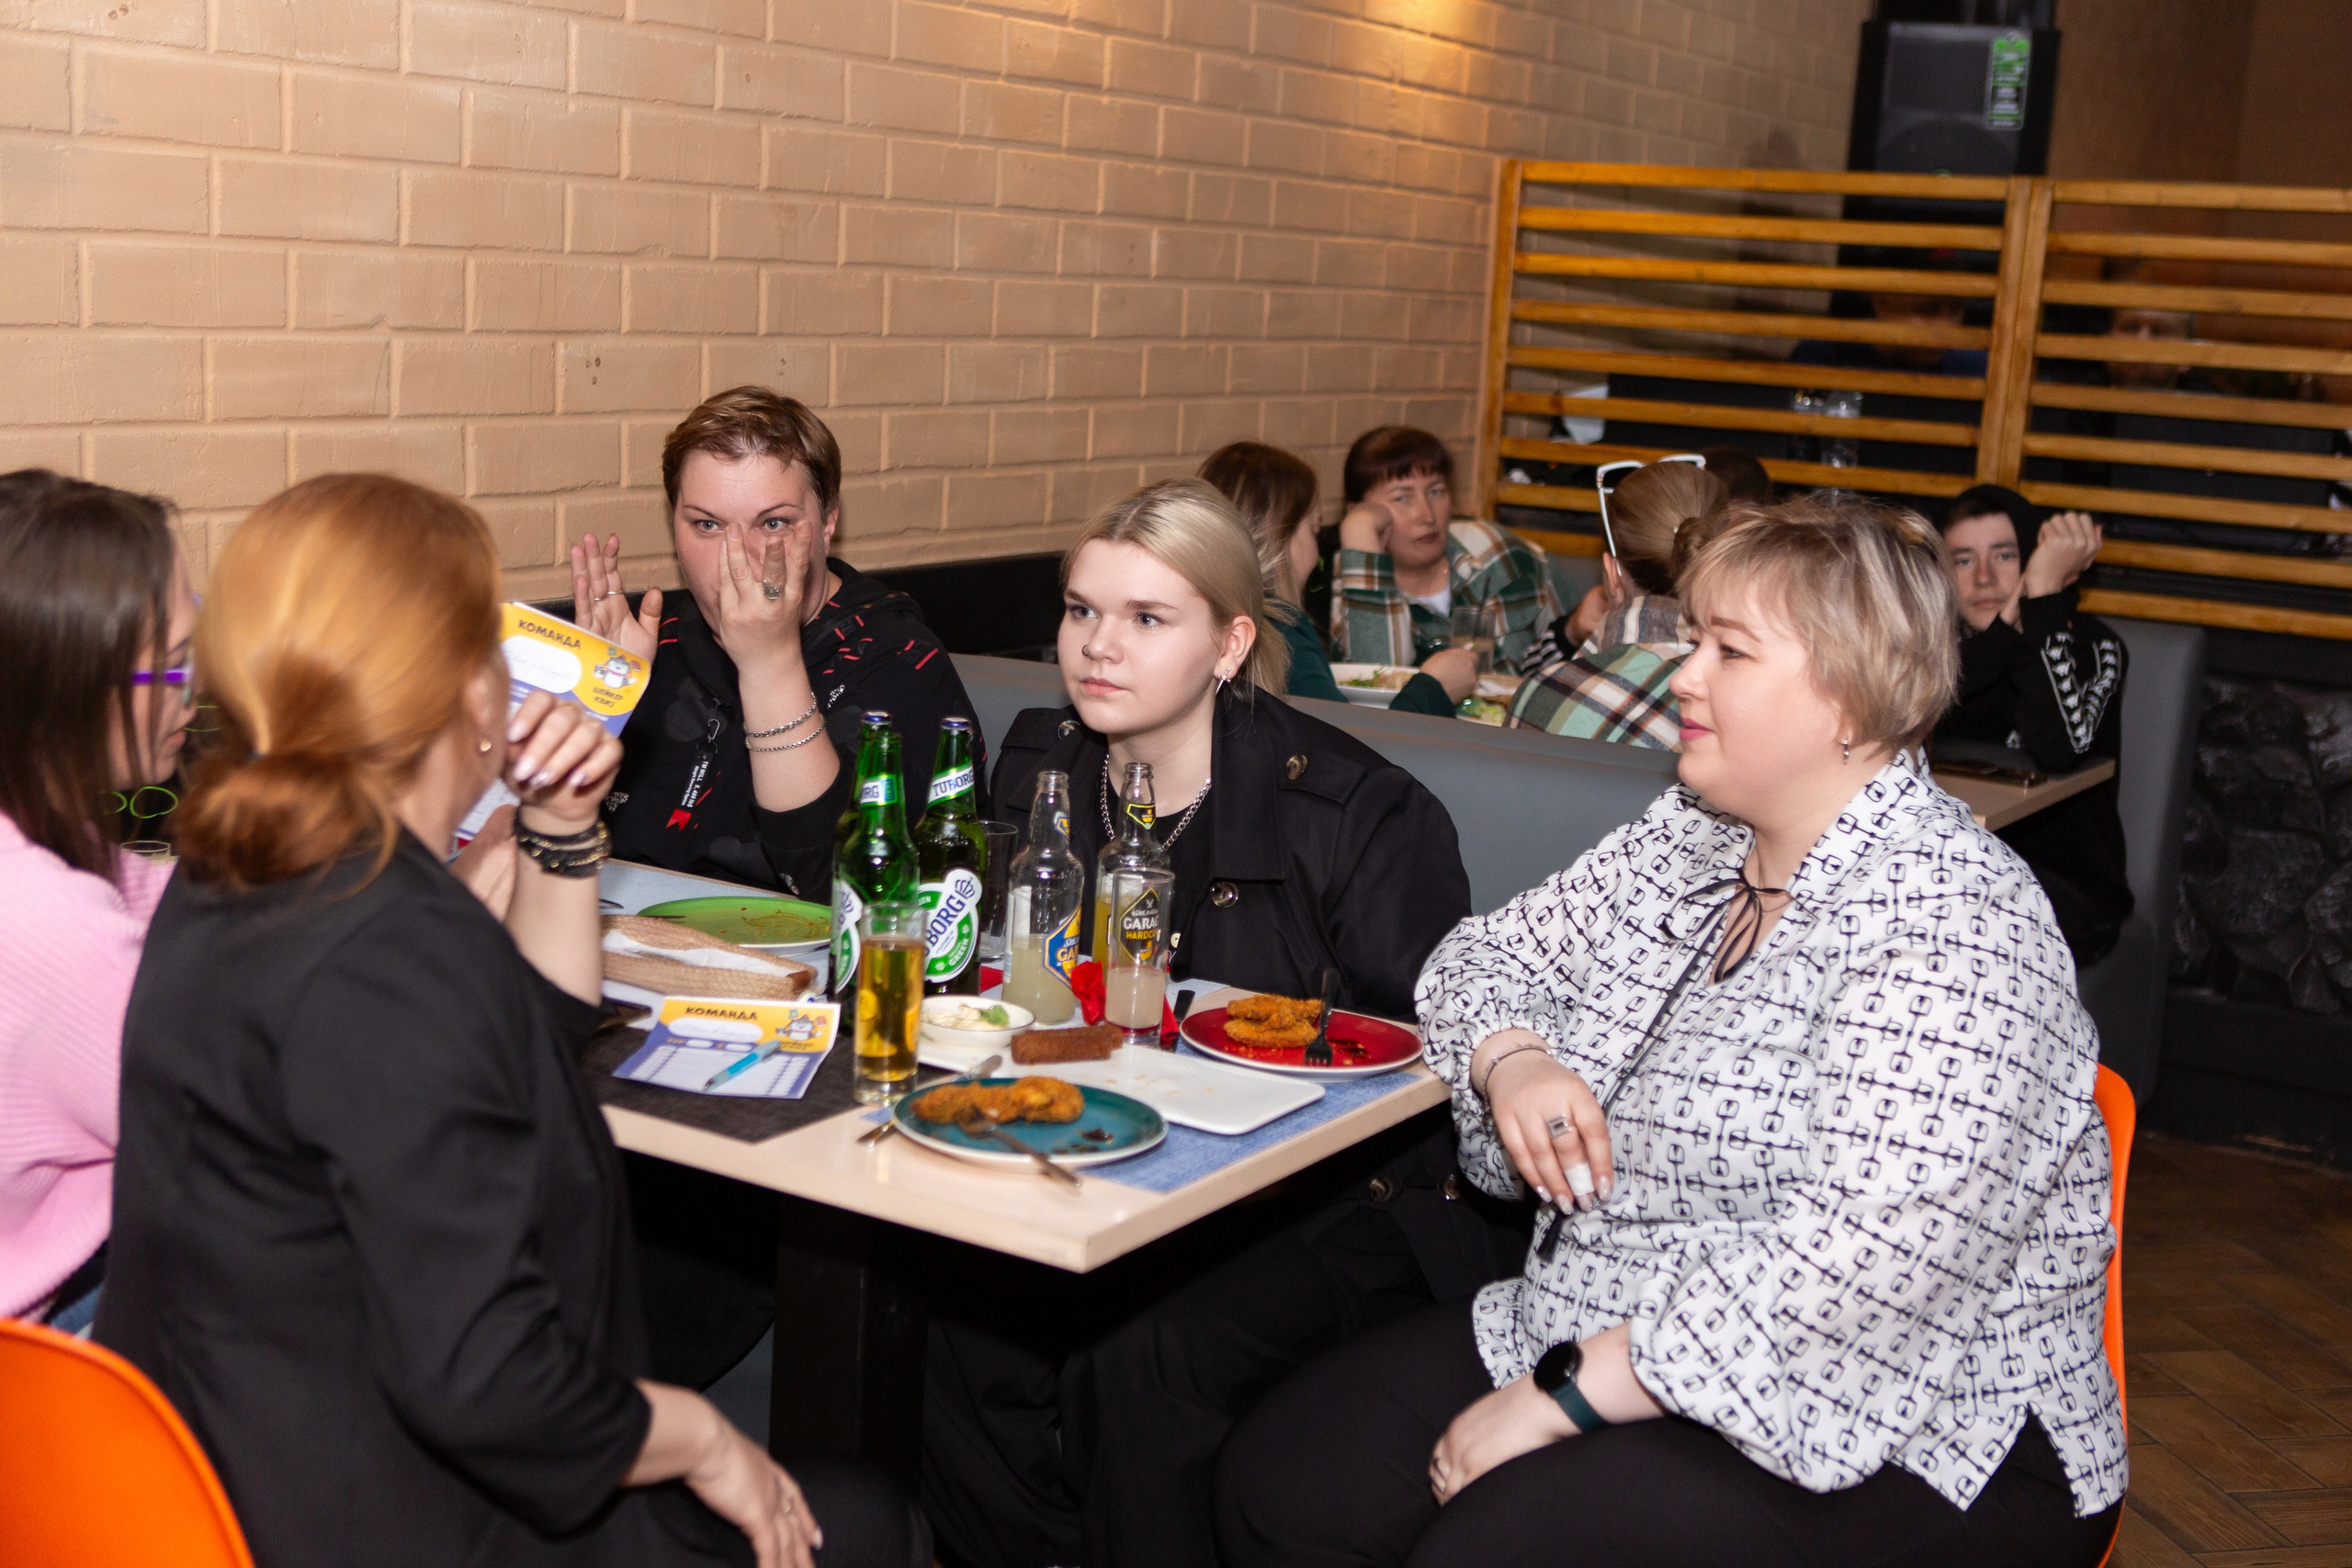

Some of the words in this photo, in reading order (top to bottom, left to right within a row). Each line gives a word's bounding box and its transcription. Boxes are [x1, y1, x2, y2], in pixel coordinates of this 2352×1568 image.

[518, 619, 582, 650] КОМАНДА
[924, 895, 967, 956] BORG
[948, 938, 969, 966] GREEN
[685, 1006, 757, 1021] КОМАНДА
